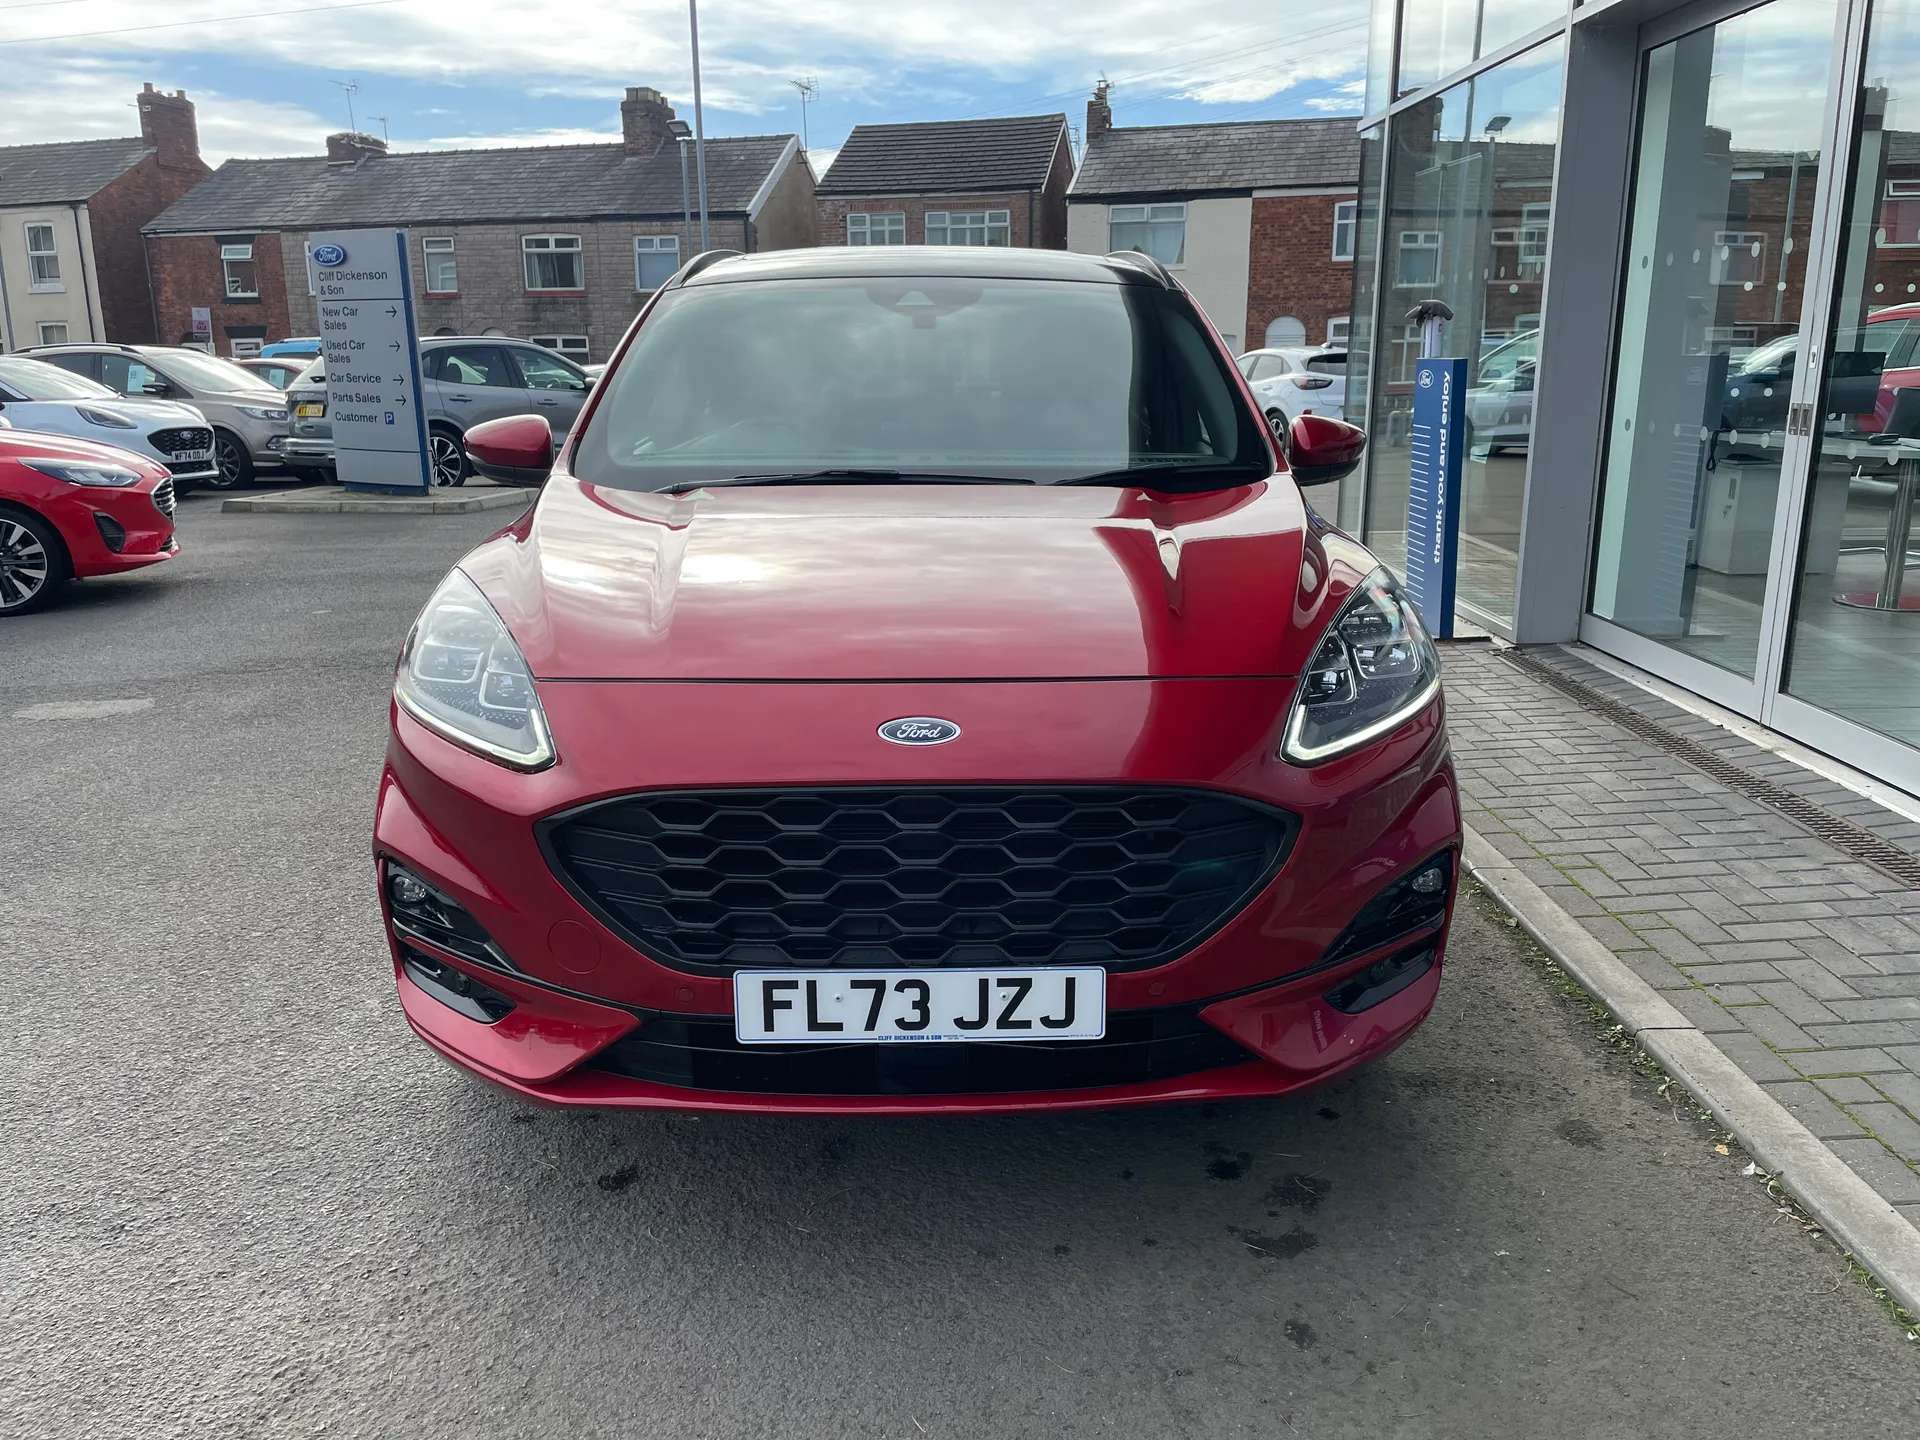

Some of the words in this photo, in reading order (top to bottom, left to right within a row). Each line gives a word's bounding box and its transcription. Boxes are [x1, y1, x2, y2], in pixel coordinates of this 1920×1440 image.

[319, 247, 338, 262] Ford
[318, 271, 334, 281] Cliff
[336, 270, 388, 281] Dickenson
[320, 285, 326, 295] &
[328, 285, 344, 295] Son
[322, 307, 340, 317] New
[342, 306, 358, 317] Car
[324, 320, 347, 330] Sales
[326, 340, 347, 350] Used
[349, 340, 365, 350] Car
[328, 353, 351, 363] Sales
[330, 372, 345, 383] Car
[346, 373, 382, 383] Service
[332, 392, 353, 402] Parts
[355, 393, 381, 403] Sales
[1441, 370, 1451, 425] enjoy
[335, 411, 378, 423] Customer
[1439, 428, 1447, 467] and
[1437, 470, 1445, 505] you
[1433, 509, 1443, 564] thank
[896, 722, 942, 738] Ford
[762, 978, 930, 1033] FL73
[953, 977, 1076, 1031] JZJ
